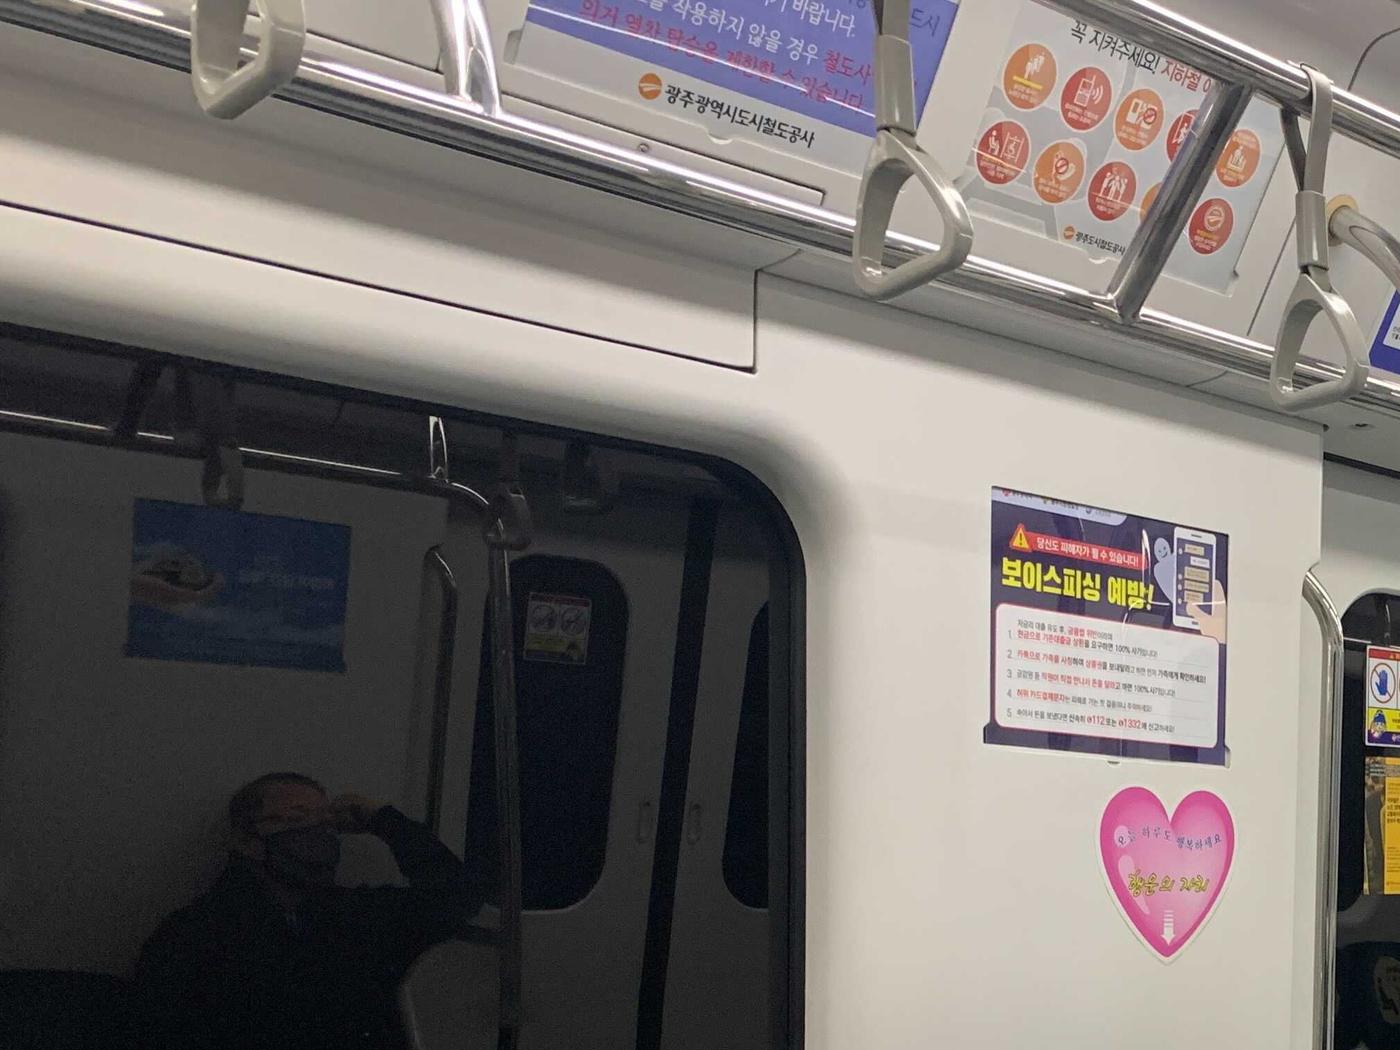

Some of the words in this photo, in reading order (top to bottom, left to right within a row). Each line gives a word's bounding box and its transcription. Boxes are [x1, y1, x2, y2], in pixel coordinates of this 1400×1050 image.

[749, 23, 783, 53] 않을
[786, 37, 818, 64] 경우
[1071, 20, 1088, 44] 꼭
[1089, 29, 1160, 75] 지켜주세요!
[1161, 60, 1202, 92] 지하철
[665, 84, 815, 148] 광주광역시도시철도공사
[1036, 536, 1059, 551] 당신도
[1060, 541, 1090, 559] 피해자가
[1100, 548, 1108, 560] 수
[1108, 550, 1139, 567] 있습니다!
[1001, 557, 1101, 602] 보이스피싱
[1107, 576, 1154, 611] 예방!
